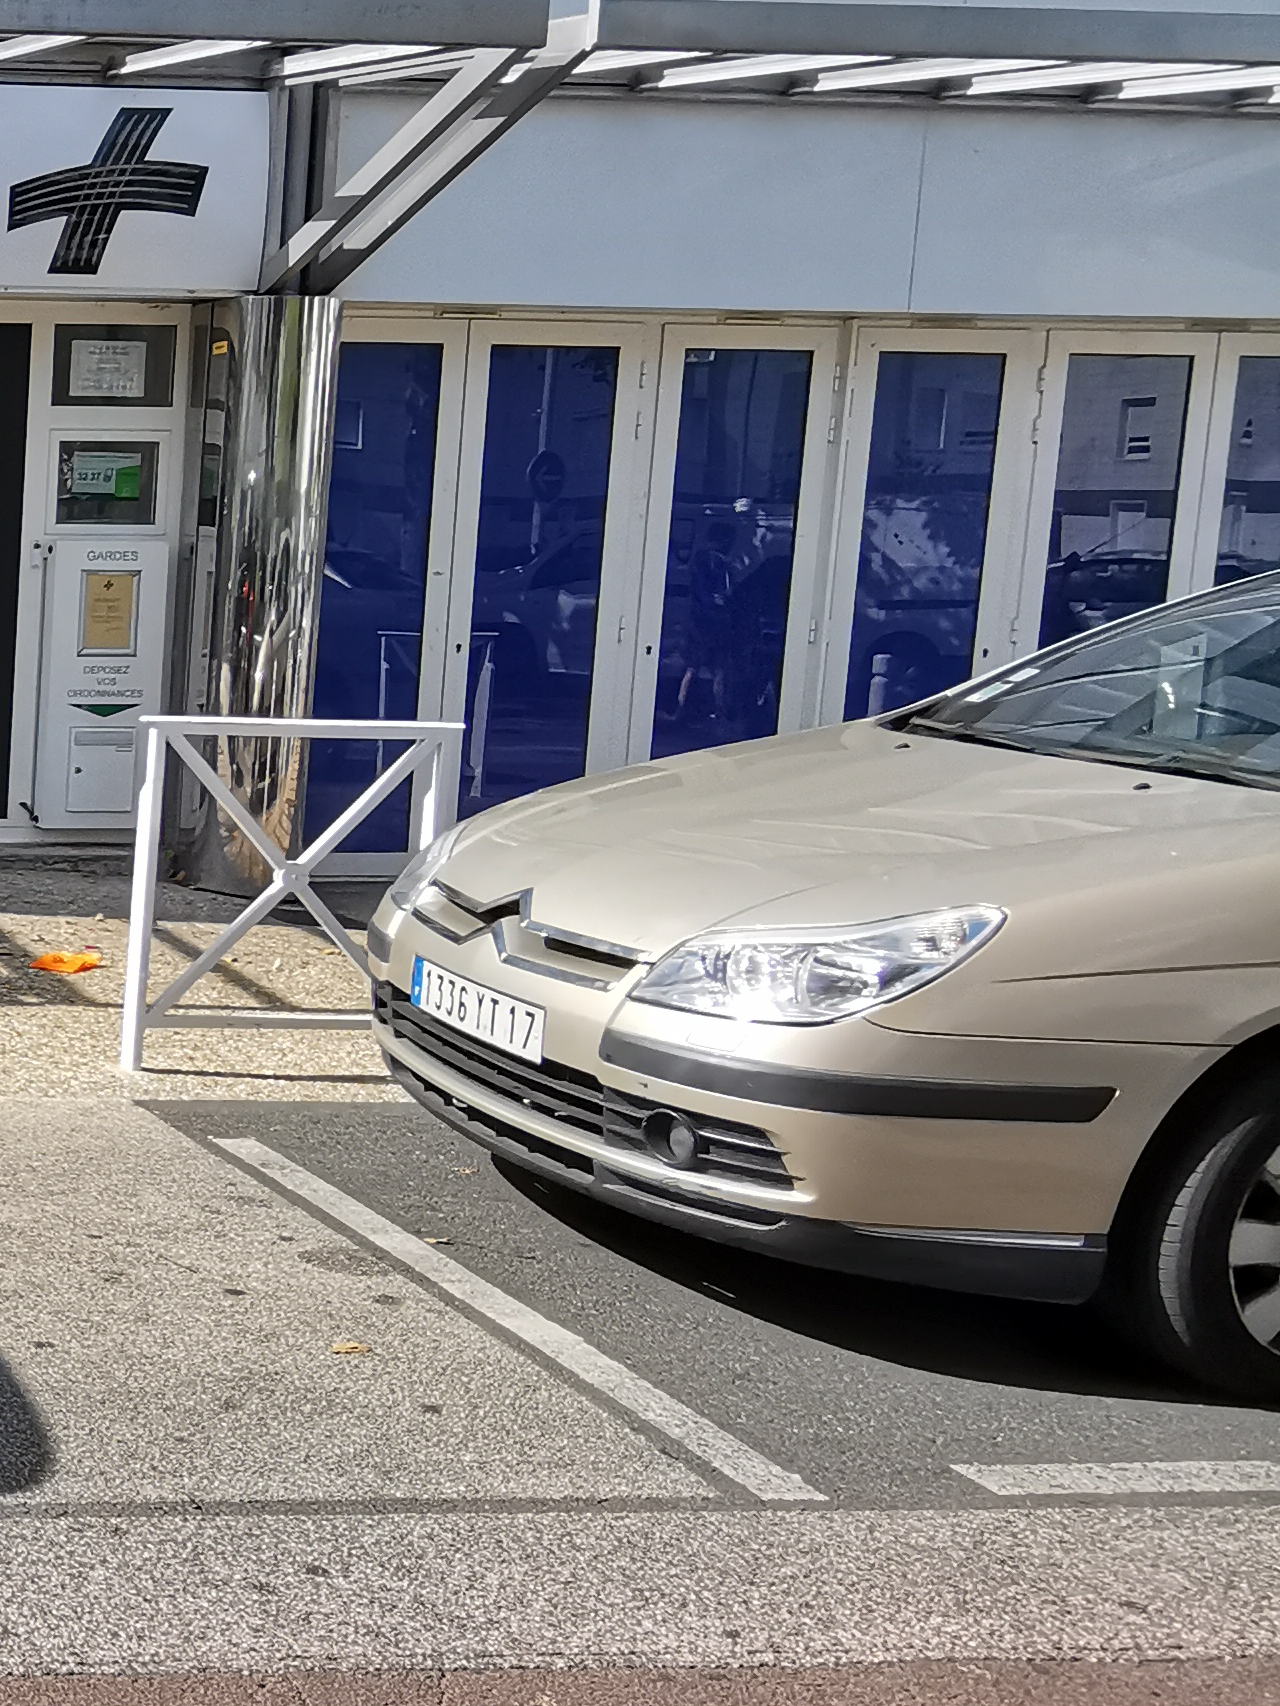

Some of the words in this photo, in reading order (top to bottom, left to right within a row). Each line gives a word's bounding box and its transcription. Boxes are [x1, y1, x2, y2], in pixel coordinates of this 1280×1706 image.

[86, 549, 139, 562] GARDES
[425, 969, 469, 1023] 1336
[476, 990, 500, 1037] YT
[509, 1005, 536, 1050] 17
